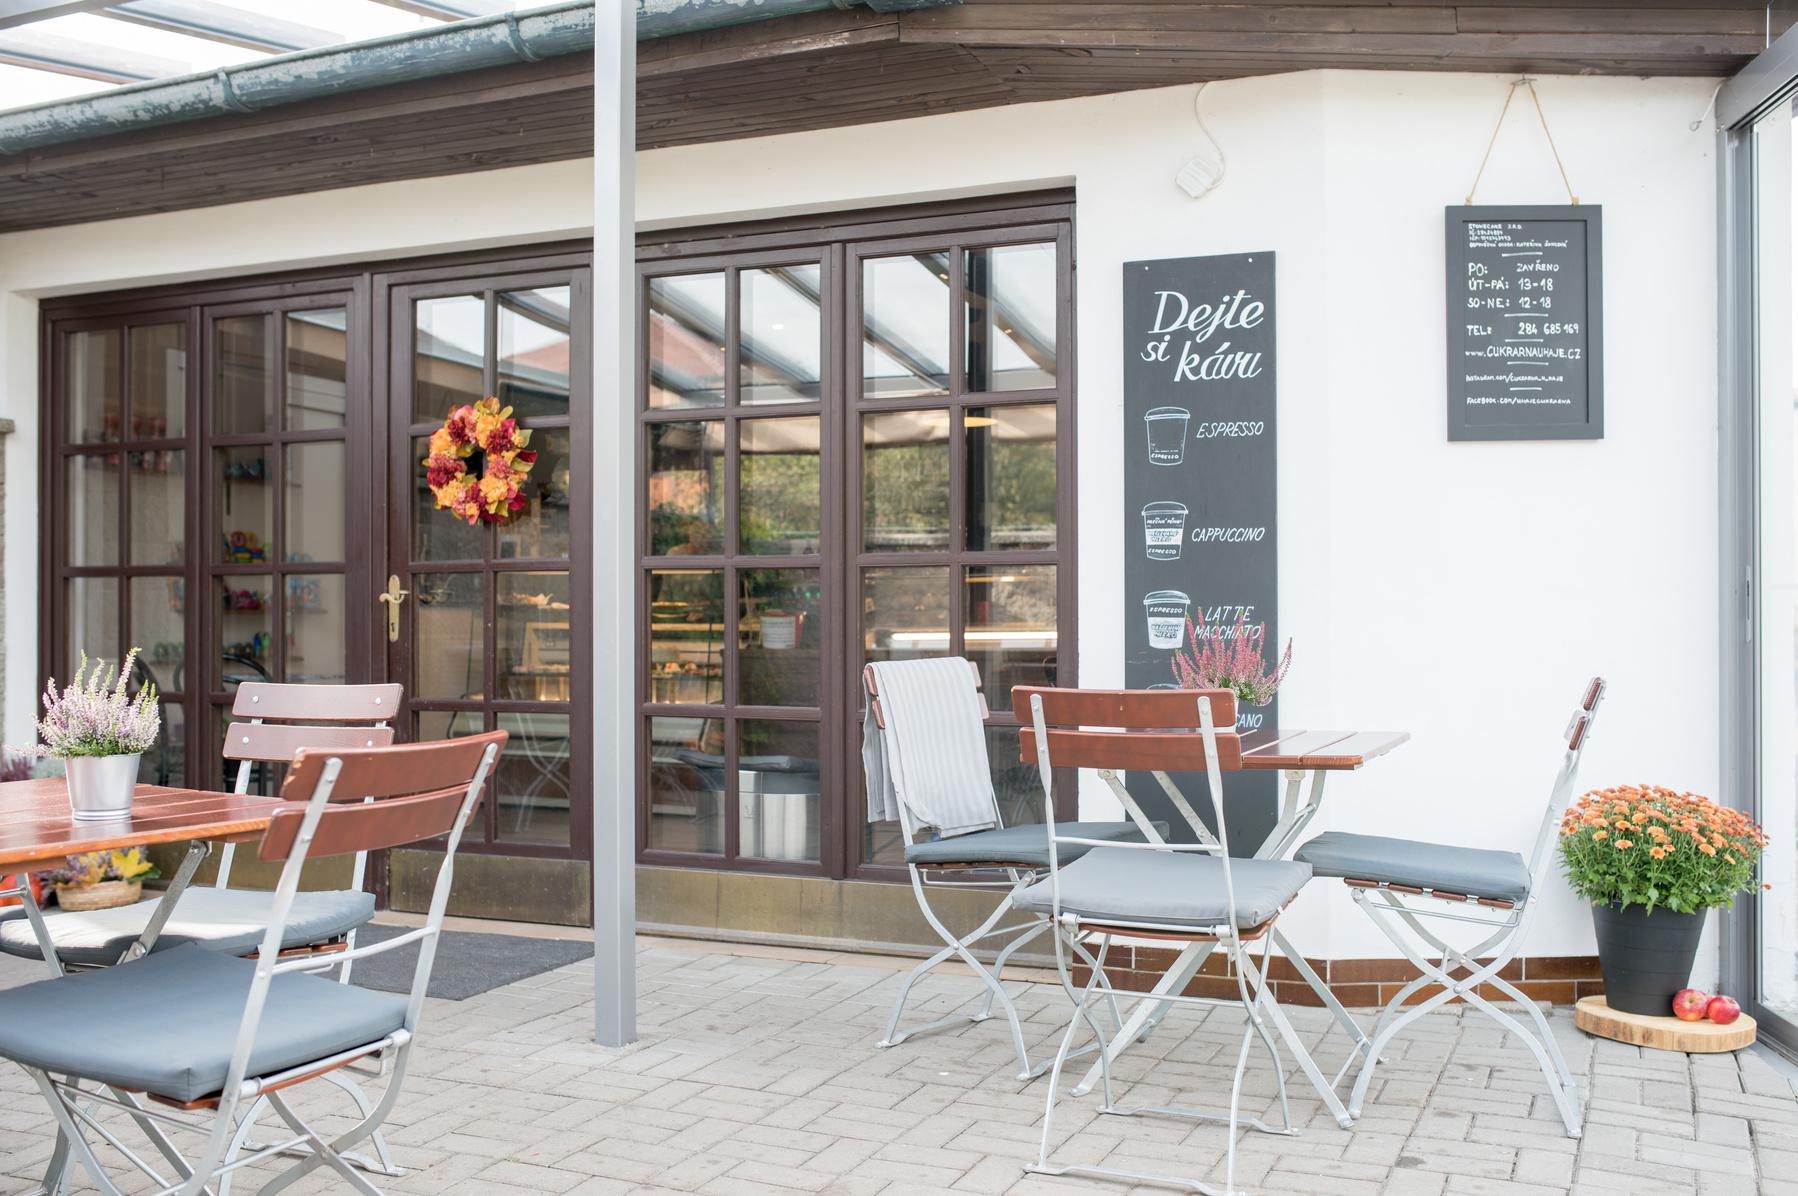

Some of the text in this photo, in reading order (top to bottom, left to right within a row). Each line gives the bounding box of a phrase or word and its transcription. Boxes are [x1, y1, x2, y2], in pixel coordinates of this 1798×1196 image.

[1468, 259, 1560, 276] PO: ZAVŘENO
[1148, 289, 1265, 343] Dejte
[1466, 322, 1579, 336] TEL: 284 685 169
[1140, 334, 1263, 382] si kávu
[1196, 421, 1264, 438] ESPRESSO
[1191, 527, 1265, 542] CAPPUCCINO
[1205, 606, 1255, 621] LATTE
